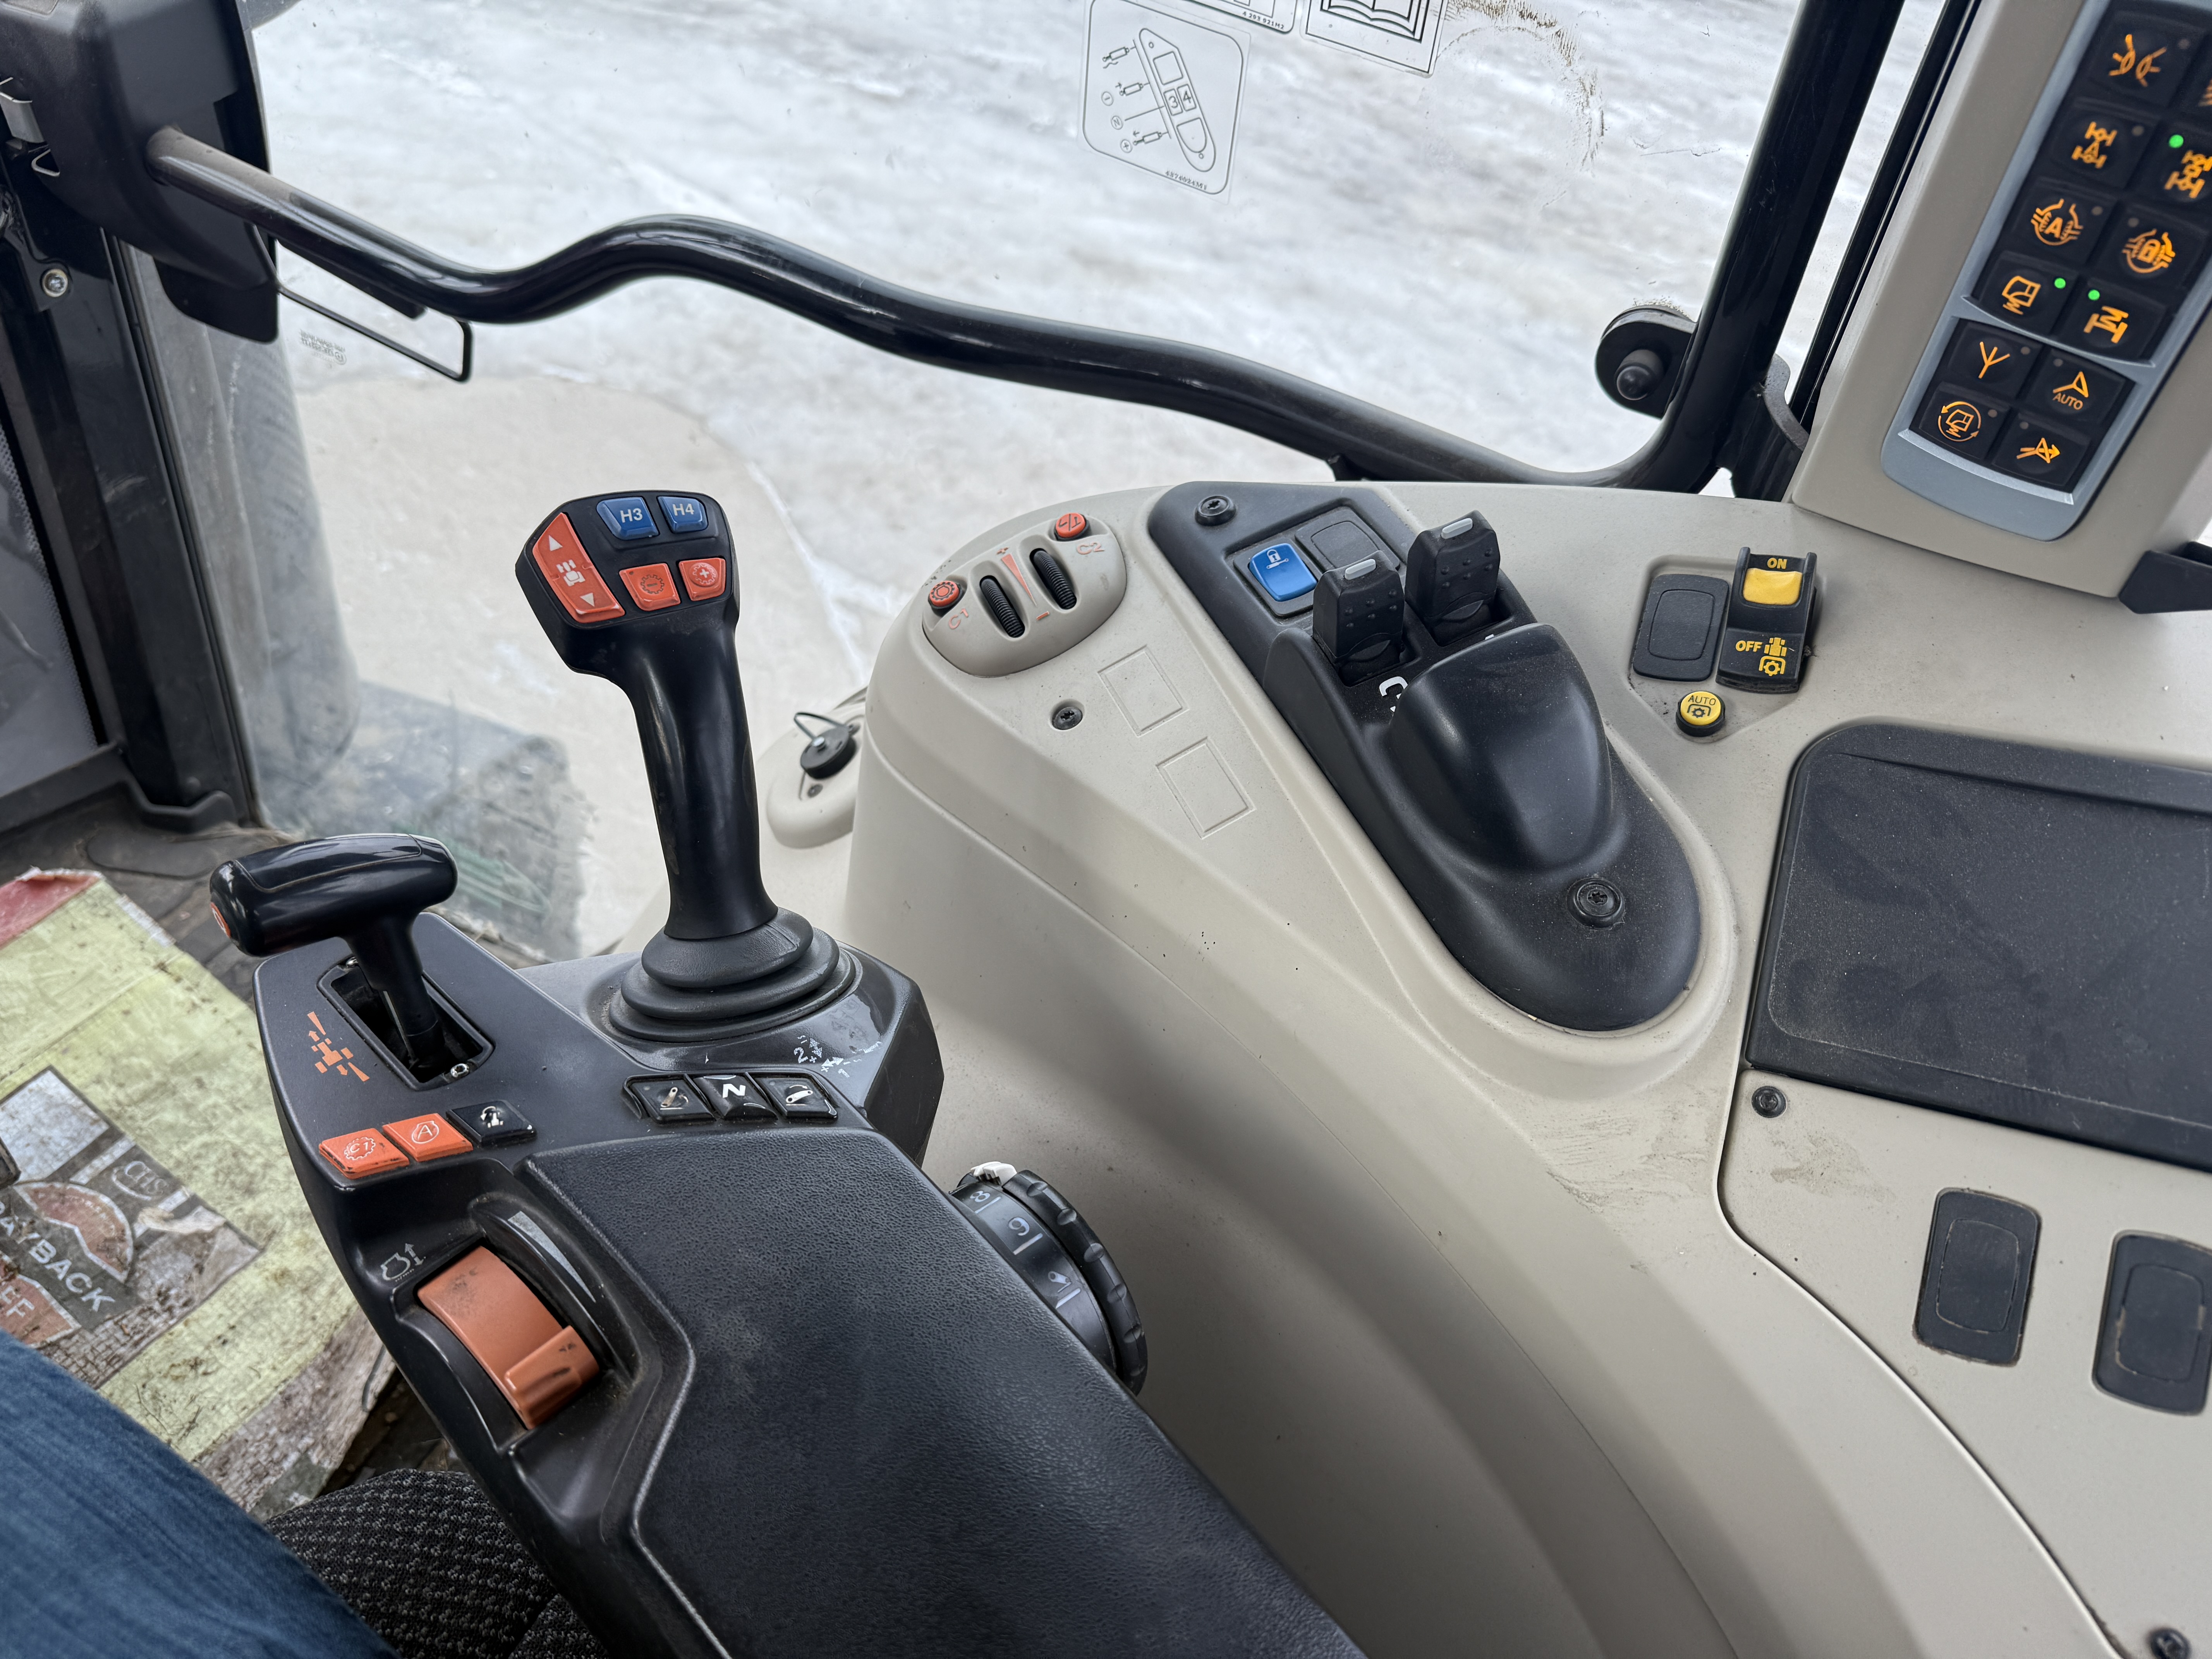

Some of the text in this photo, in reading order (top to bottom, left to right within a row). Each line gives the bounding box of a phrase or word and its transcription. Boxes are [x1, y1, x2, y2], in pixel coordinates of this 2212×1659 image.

[1168, 91, 1192, 108] 3 4
[1113, 117, 1120, 127] N
[2044, 217, 2063, 239] A
[2052, 392, 2083, 410] AUTO
[620, 508, 643, 523] H3
[672, 503, 695, 516] H4
[1077, 541, 1105, 555] C2
[1767, 557, 1787, 569] ON
[948, 608, 969, 630] C1
[1735, 640, 1763, 652] OFF
[1688, 695, 1716, 706] AUTO
[793, 1047, 809, 1064] 2
[722, 1083, 746, 1098] N
[417, 1124, 433, 1140] A
[350, 1142, 369, 1153] C1
[969, 1190, 991, 1202] 8
[0, 1201, 115, 1312] AYBACK
